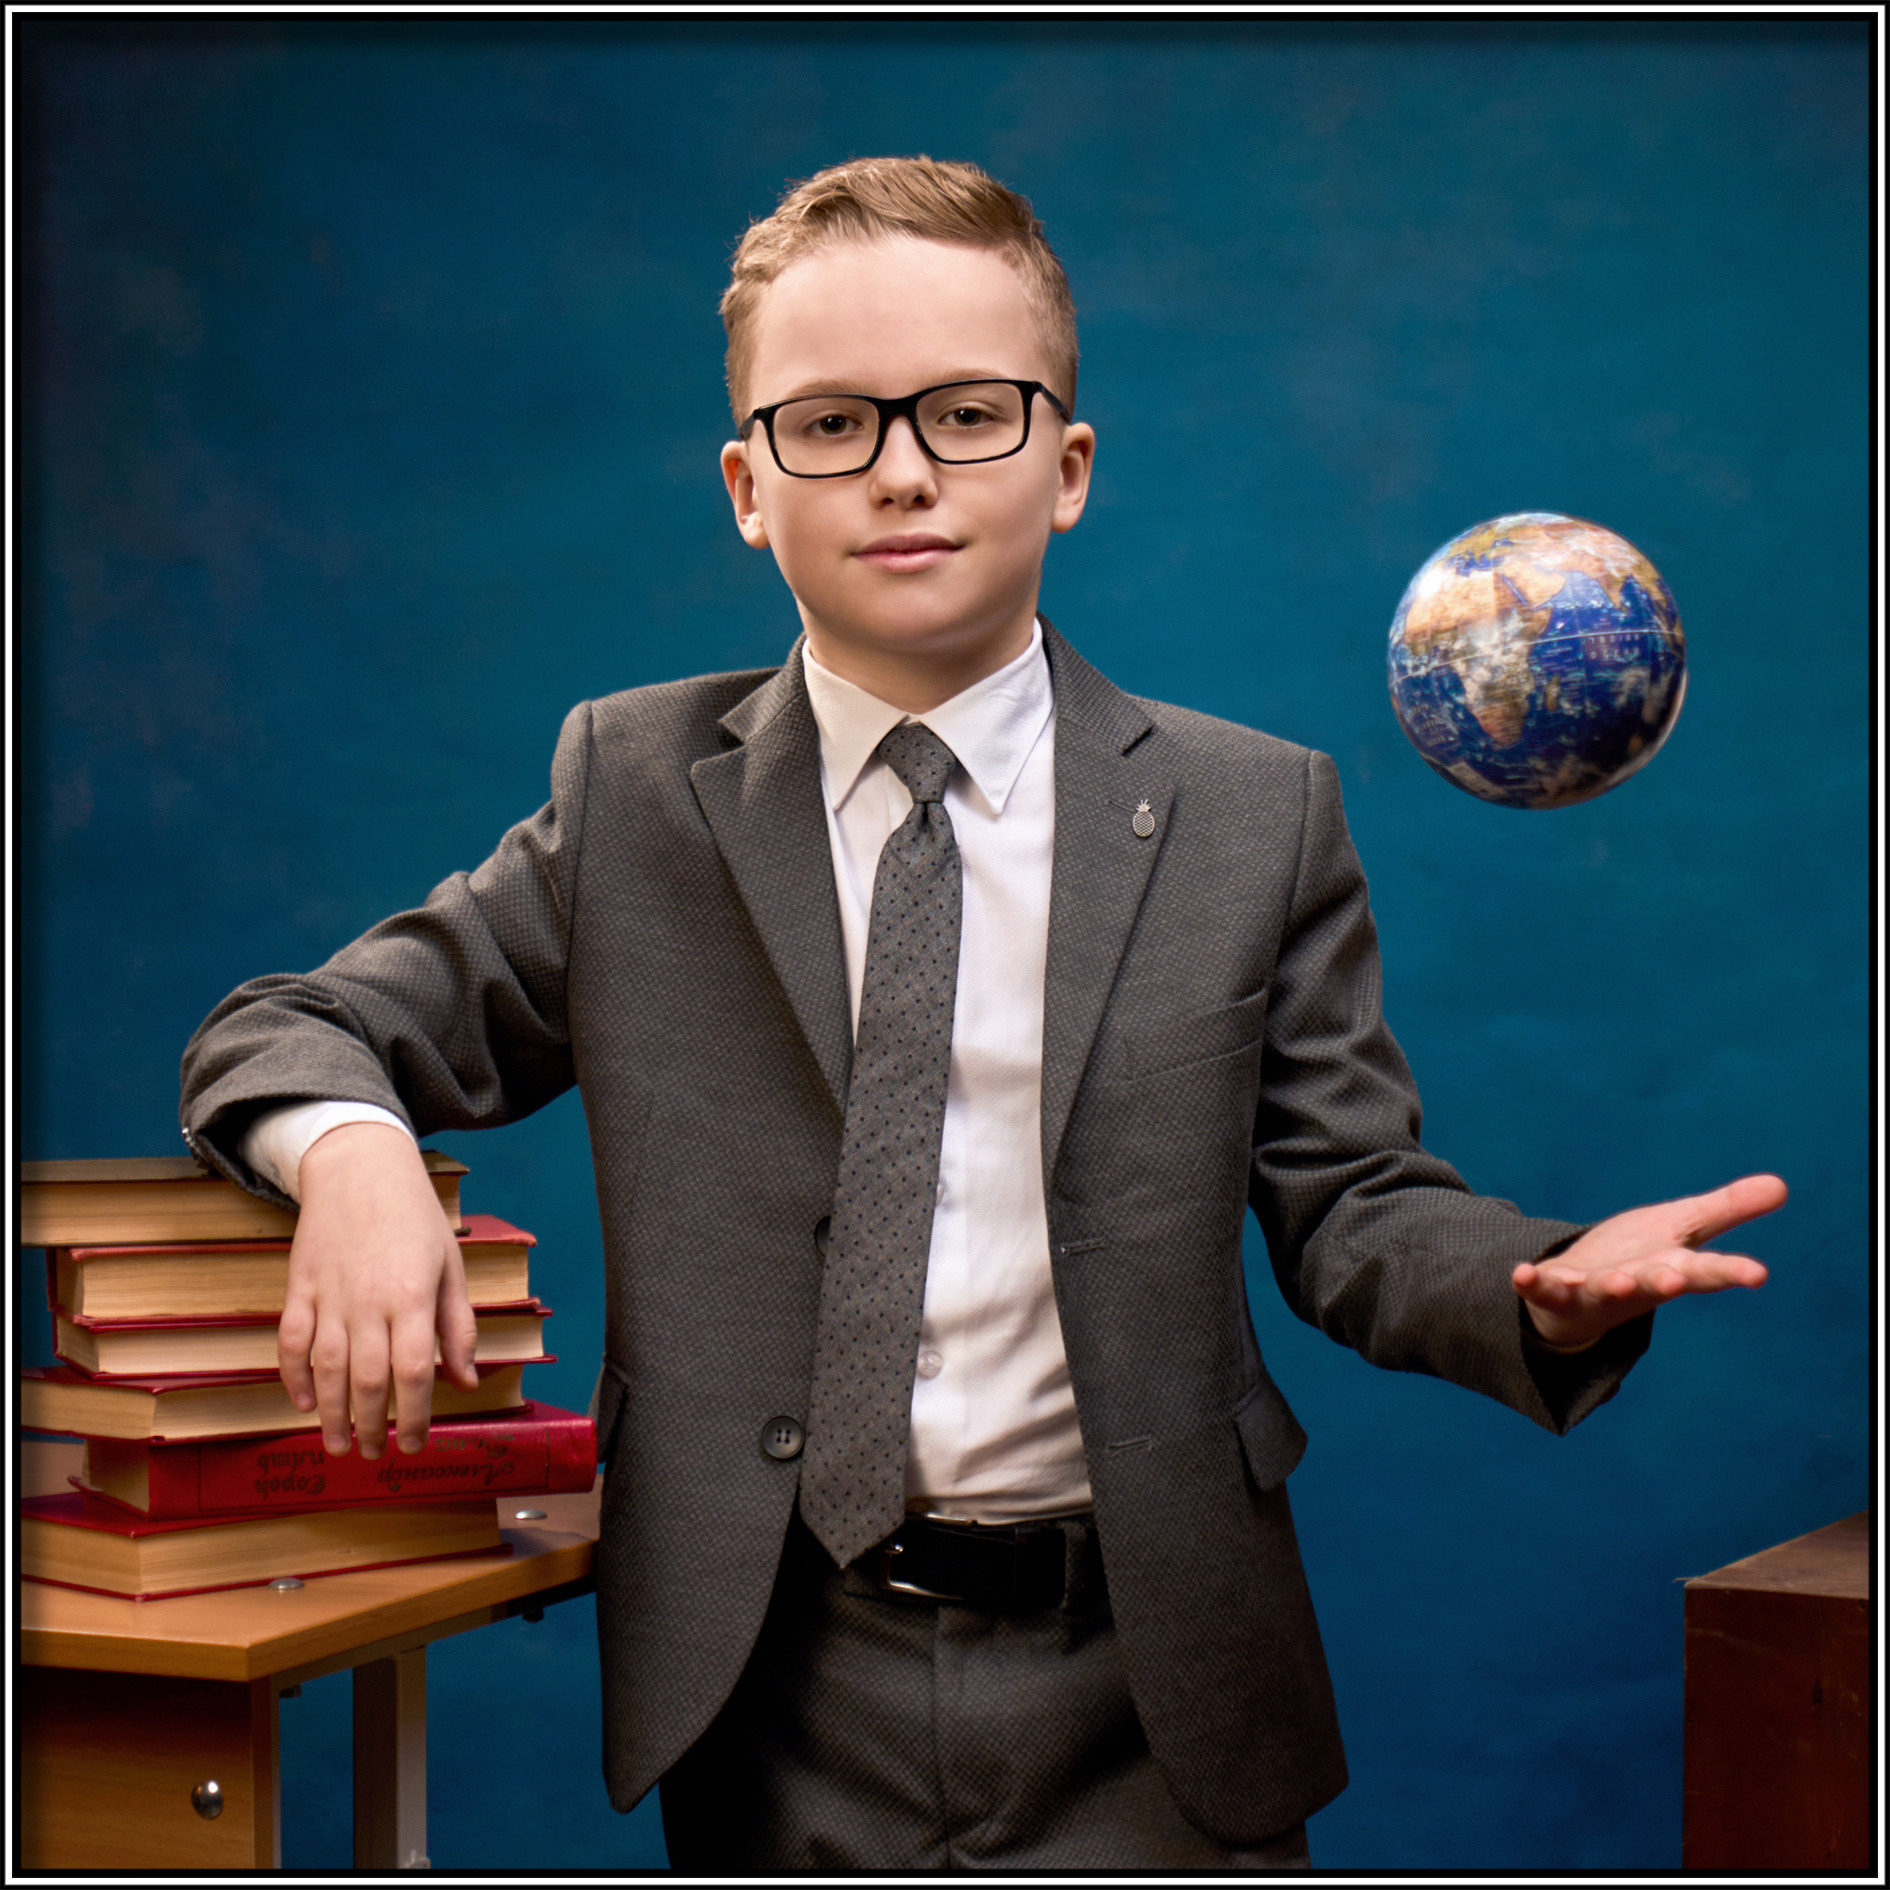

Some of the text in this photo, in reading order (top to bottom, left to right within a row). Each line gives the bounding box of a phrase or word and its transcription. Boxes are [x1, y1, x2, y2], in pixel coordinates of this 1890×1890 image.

[434, 1434, 515, 1459] Дюма
[257, 1449, 325, 1475] пять
[377, 1459, 515, 1492] Александр
[255, 1471, 326, 1500] Сорок
